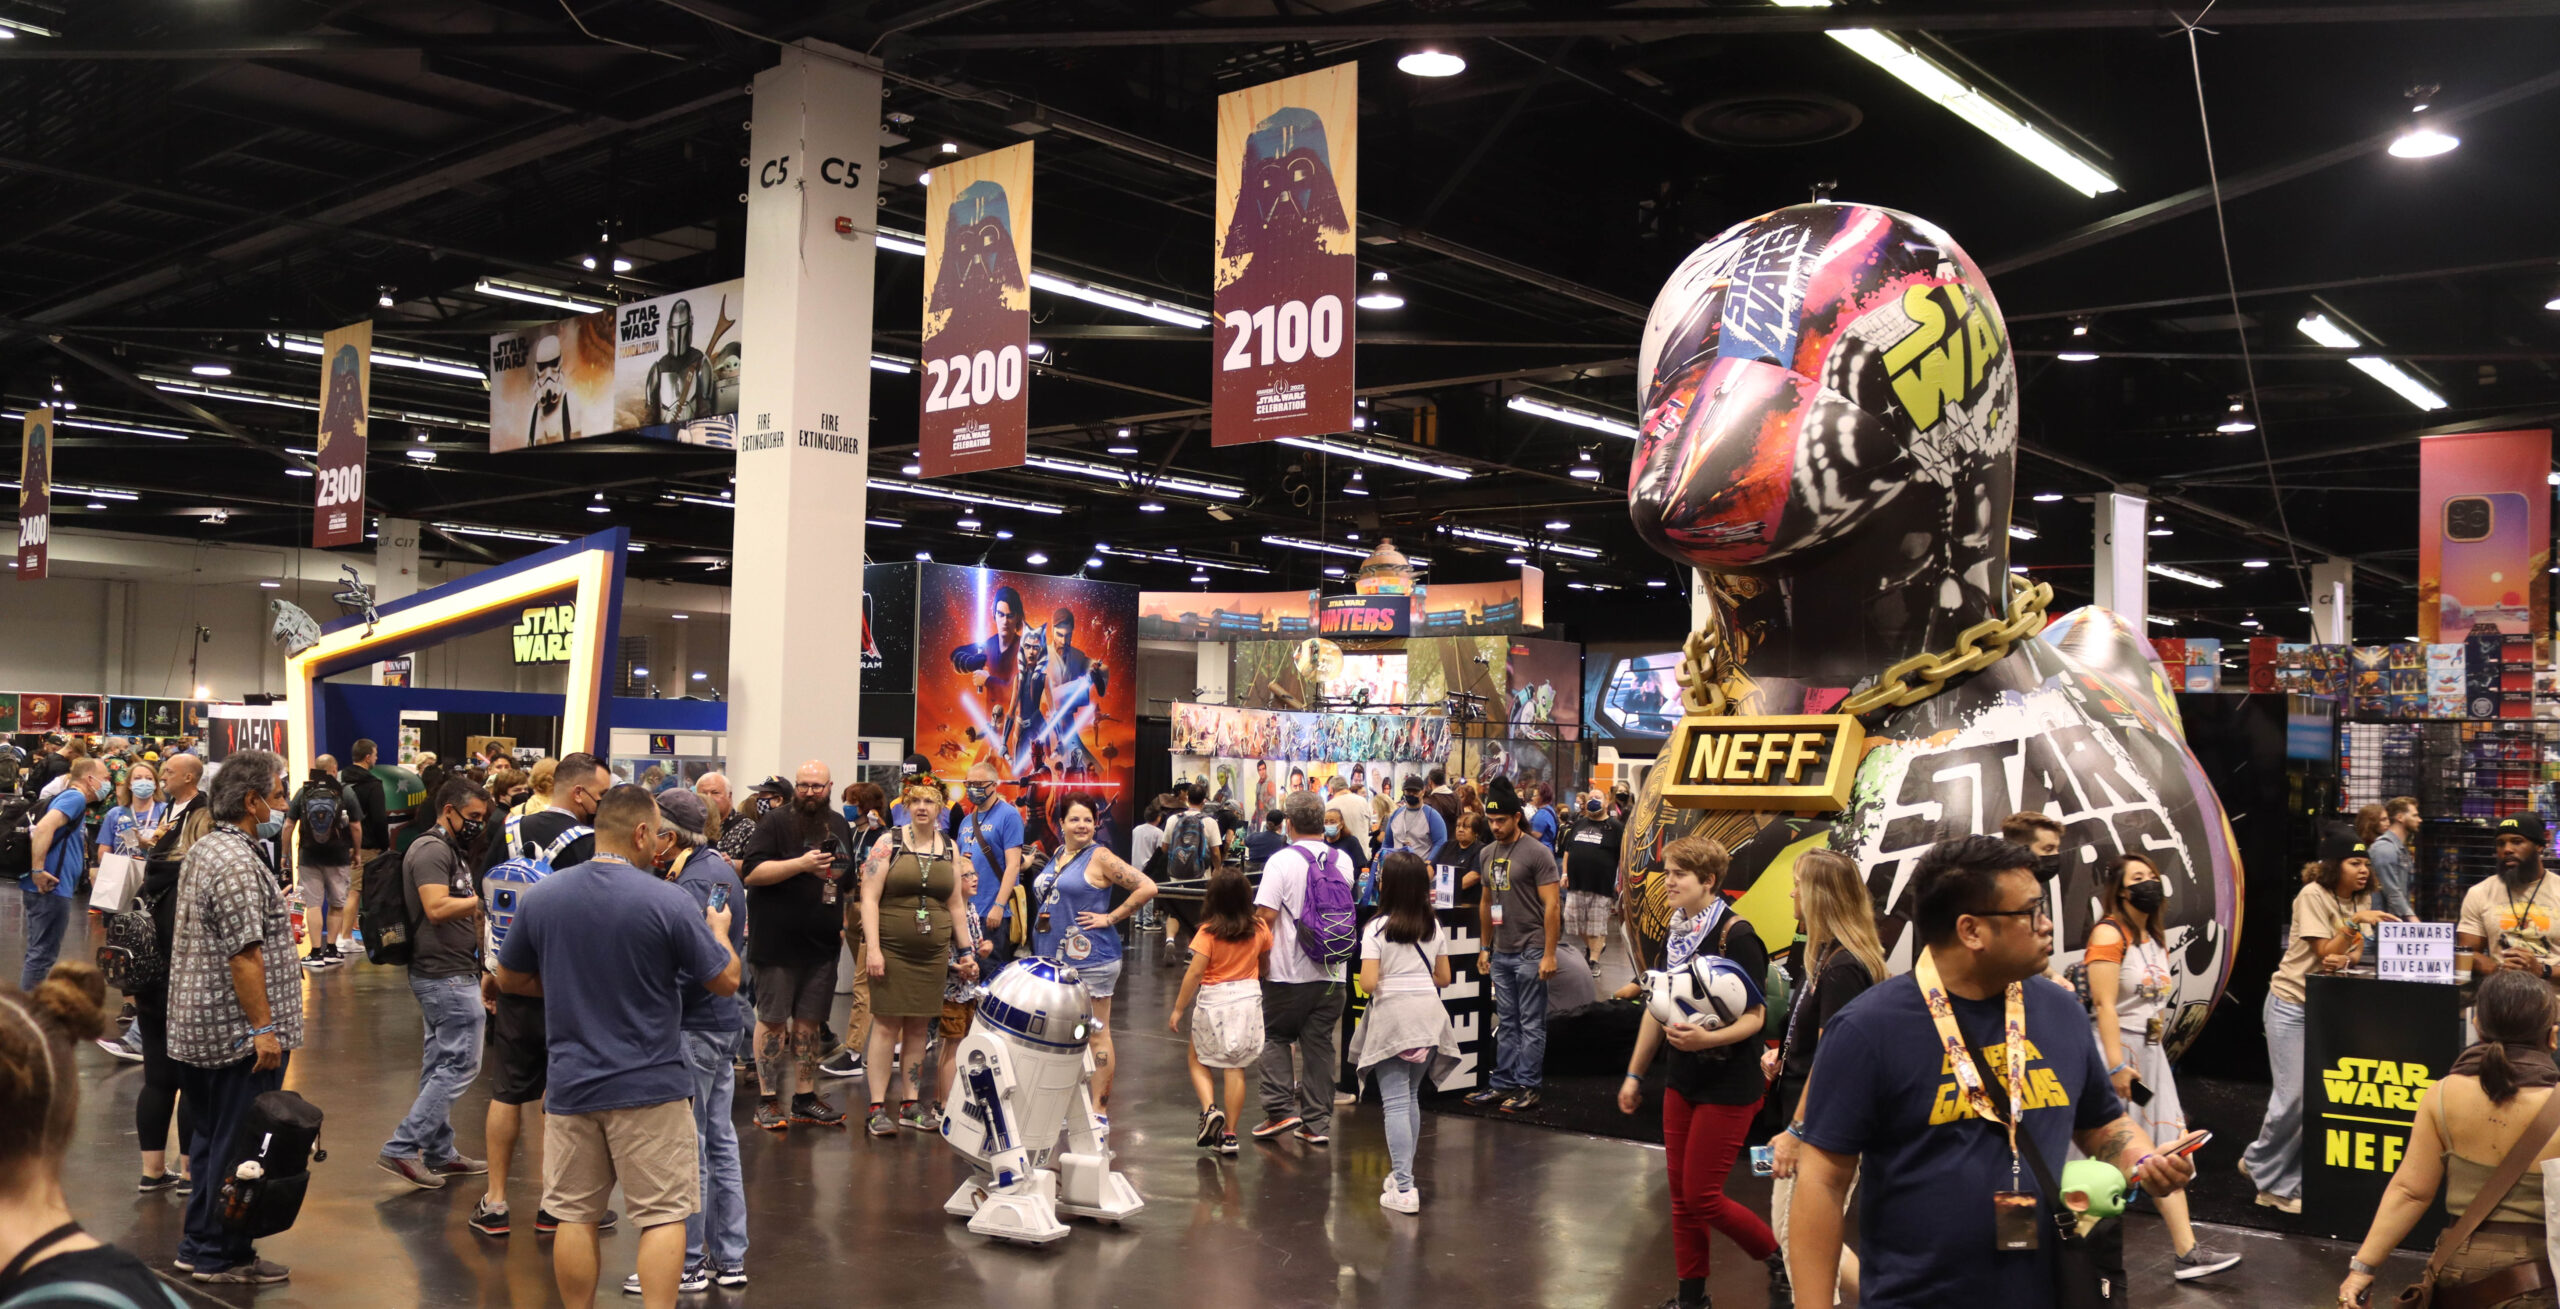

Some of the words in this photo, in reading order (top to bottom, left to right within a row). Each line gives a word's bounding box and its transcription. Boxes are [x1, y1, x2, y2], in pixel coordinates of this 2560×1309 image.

[760, 156, 790, 189] C5
[820, 157, 861, 189] C5
[620, 304, 660, 327] STAR
[620, 321, 660, 343] WARS
[1222, 294, 1343, 372] 2100
[493, 337, 528, 357] STAR
[493, 350, 528, 372] WARS
[925, 345, 1022, 413] 2200
[1256, 394, 1281, 405] STAR
[1281, 391, 1306, 401] WARS
[1256, 400, 1306, 414] CELEBRATION
[757, 413, 771, 431] FIRE
[821, 413, 839, 432] FIRE
[742, 431, 785, 452] EXTINGUISHER
[799, 430, 859, 454] EXTINGUISHER
[317, 464, 362, 507] 2300
[19, 514, 47, 547] 2400
[394, 537, 415, 548] C17
[1328, 600, 1344, 608] STAR
[1344, 599, 1367, 607] WARS
[513, 605, 575, 635] STAR
[1321, 608, 1396, 634] UNTERS
[1689, 733, 1827, 784] NEFF
[1880, 722, 2150, 854] STAR
[2396, 943, 2430, 956] NEFF
[2382, 960, 2451, 973] GIVEAWAY
[2323, 1056, 2439, 1088] STAR
[2325, 1128, 2404, 1173] NEF
